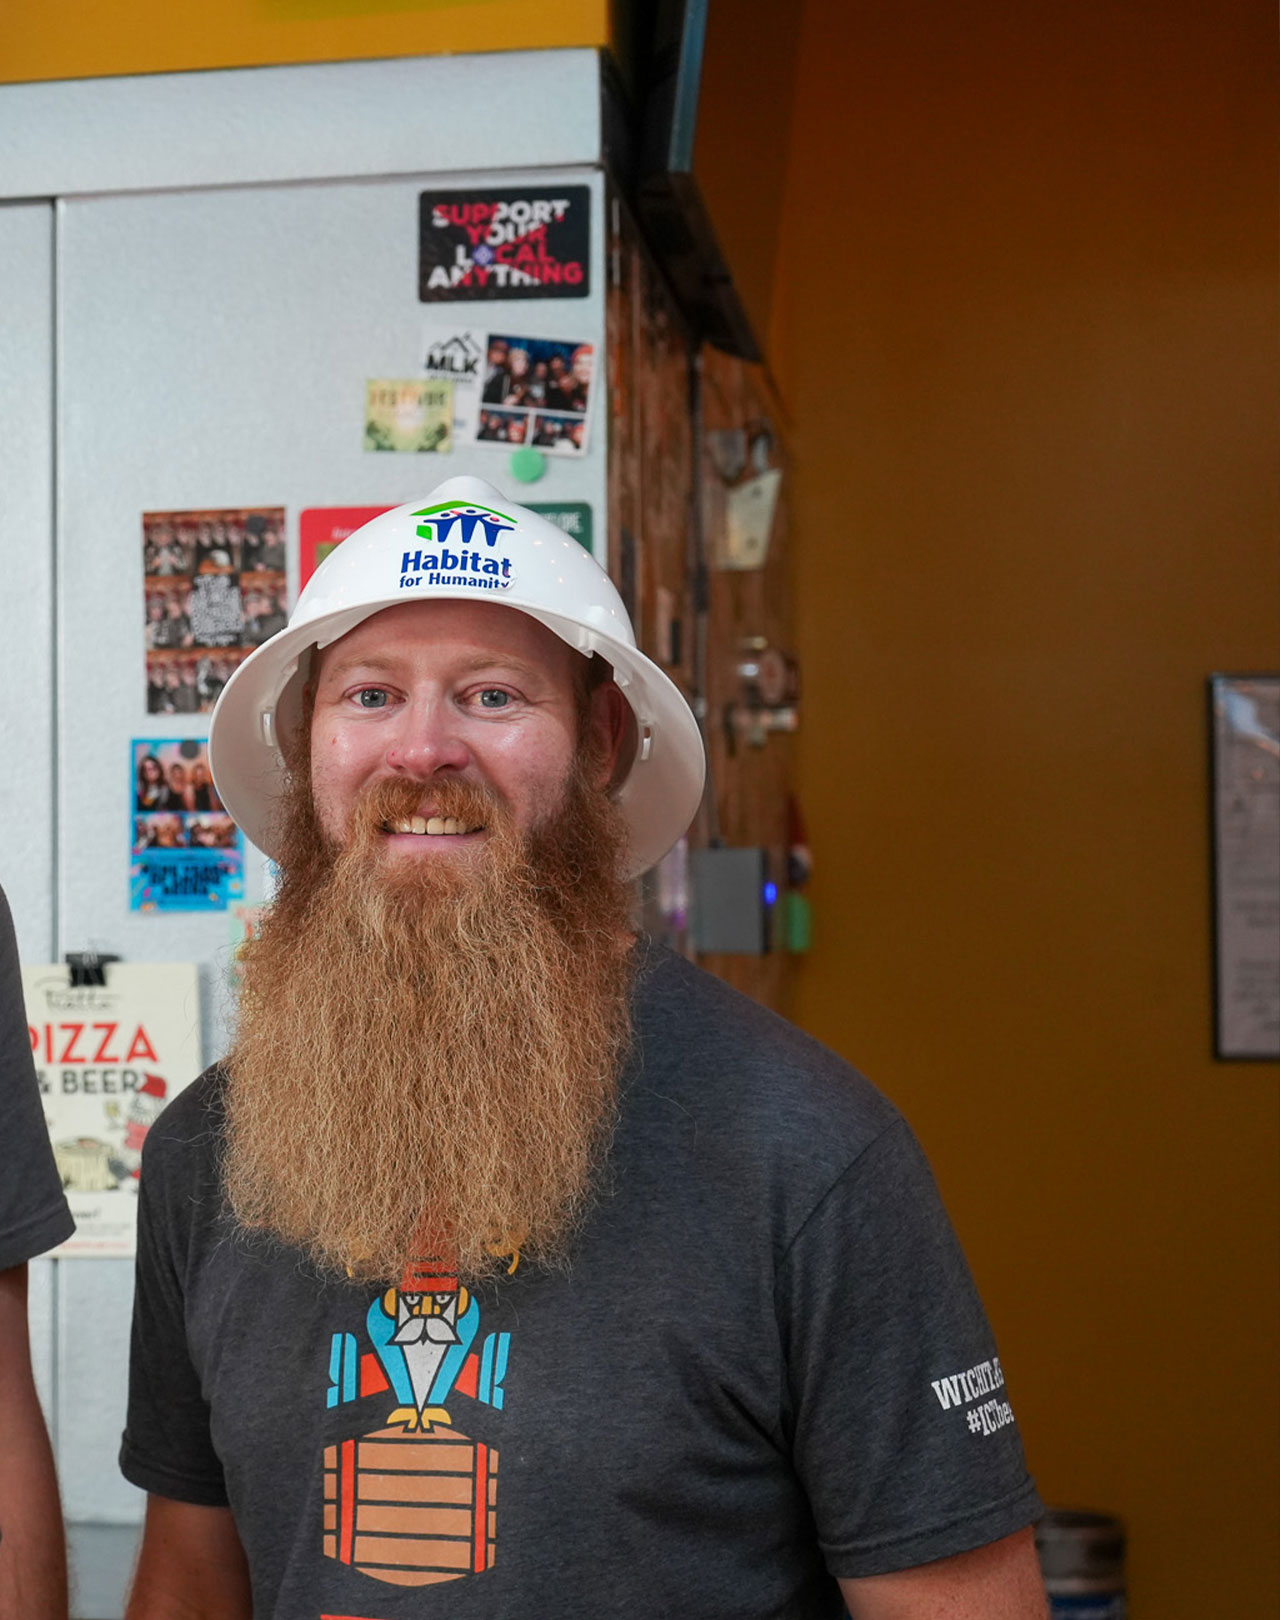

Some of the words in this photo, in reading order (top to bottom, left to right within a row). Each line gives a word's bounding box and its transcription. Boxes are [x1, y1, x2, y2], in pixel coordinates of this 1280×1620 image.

[431, 199, 570, 227] SUPPORT
[466, 222, 548, 246] YOUR
[427, 262, 584, 289] ANYTHING
[401, 549, 512, 578] Habitat
[399, 575, 423, 588] for
[61, 1069, 139, 1095] BEER
